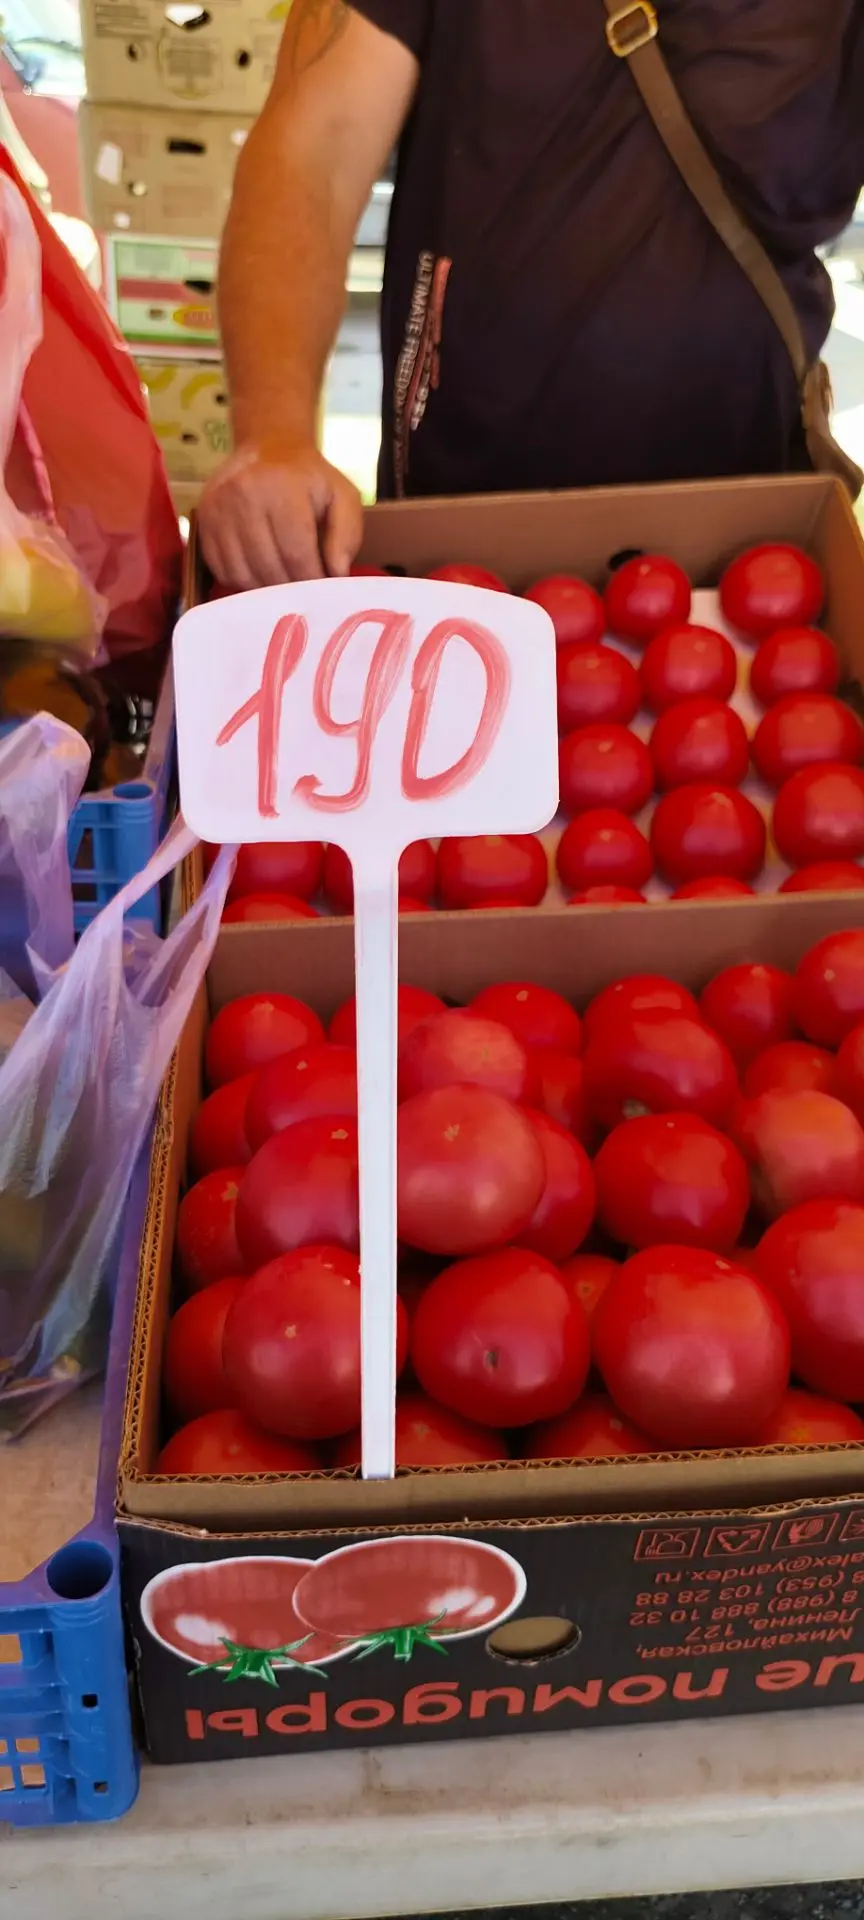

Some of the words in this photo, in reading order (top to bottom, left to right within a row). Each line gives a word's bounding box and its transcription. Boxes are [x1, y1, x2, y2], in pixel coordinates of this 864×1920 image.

[404, 250, 434, 337] ULTIMATE
[215, 608, 512, 818] 190
[719, 1581, 765, 1600] 103
[775, 1571, 845, 1594] (953)
[635, 1592, 668, 1606] 88
[677, 1588, 711, 1604] 28
[767, 1590, 835, 1613] (988)
[841, 1589, 859, 1605] 8
[629, 1611, 663, 1626] 32
[669, 1608, 700, 1623] 10
[711, 1602, 760, 1621] 888
[748, 1607, 863, 1631] Ленина,
[635, 1626, 854, 1660] Михайловская,
[684, 1623, 736, 1643] 127
[185, 1667, 730, 1741] помидоры
